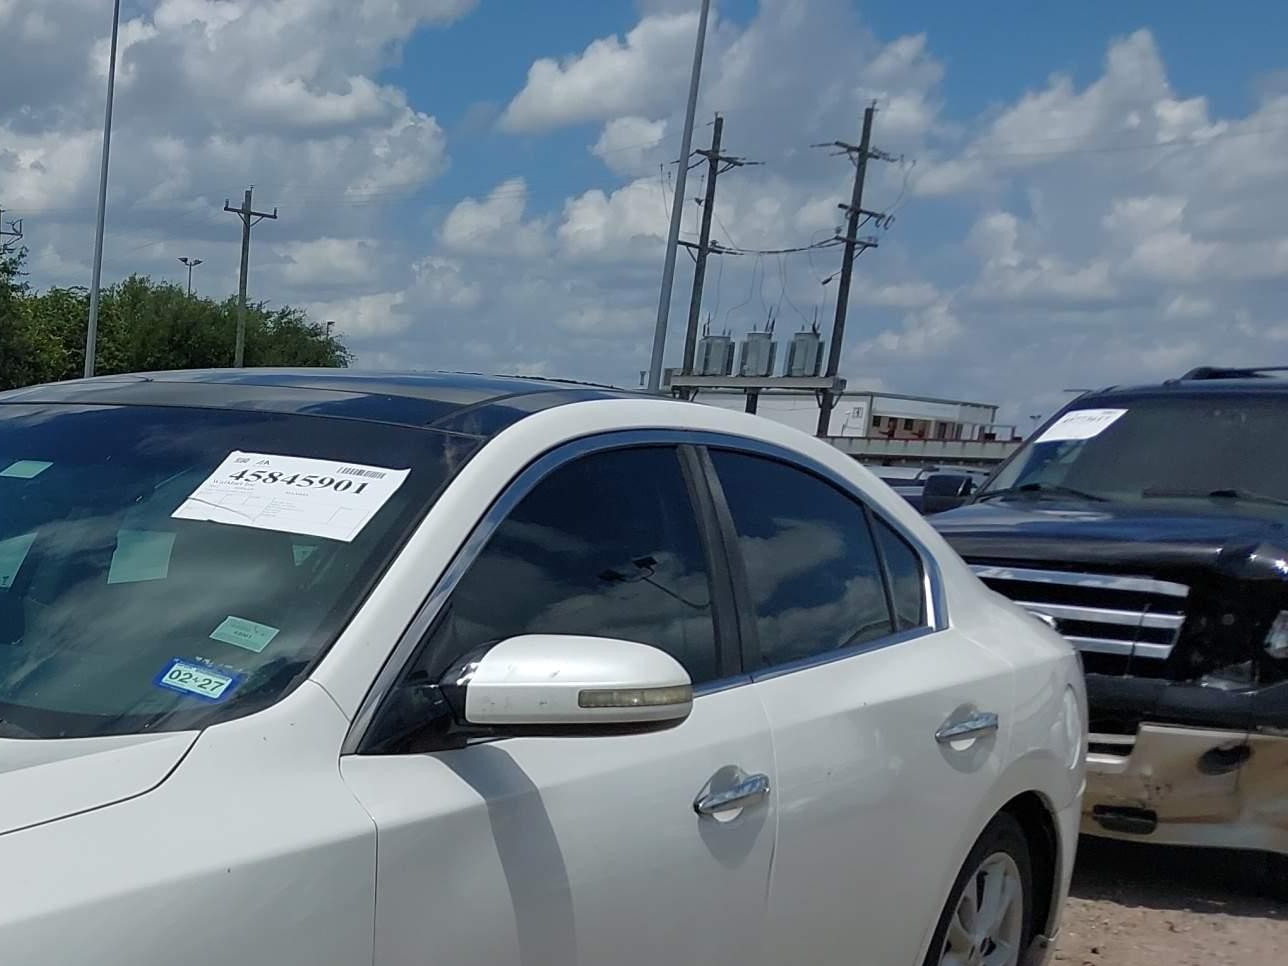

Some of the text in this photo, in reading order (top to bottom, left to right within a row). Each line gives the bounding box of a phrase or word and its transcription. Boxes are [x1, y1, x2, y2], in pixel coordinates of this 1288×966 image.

[228, 468, 369, 495] 45845901
[168, 669, 225, 692] 02 27
